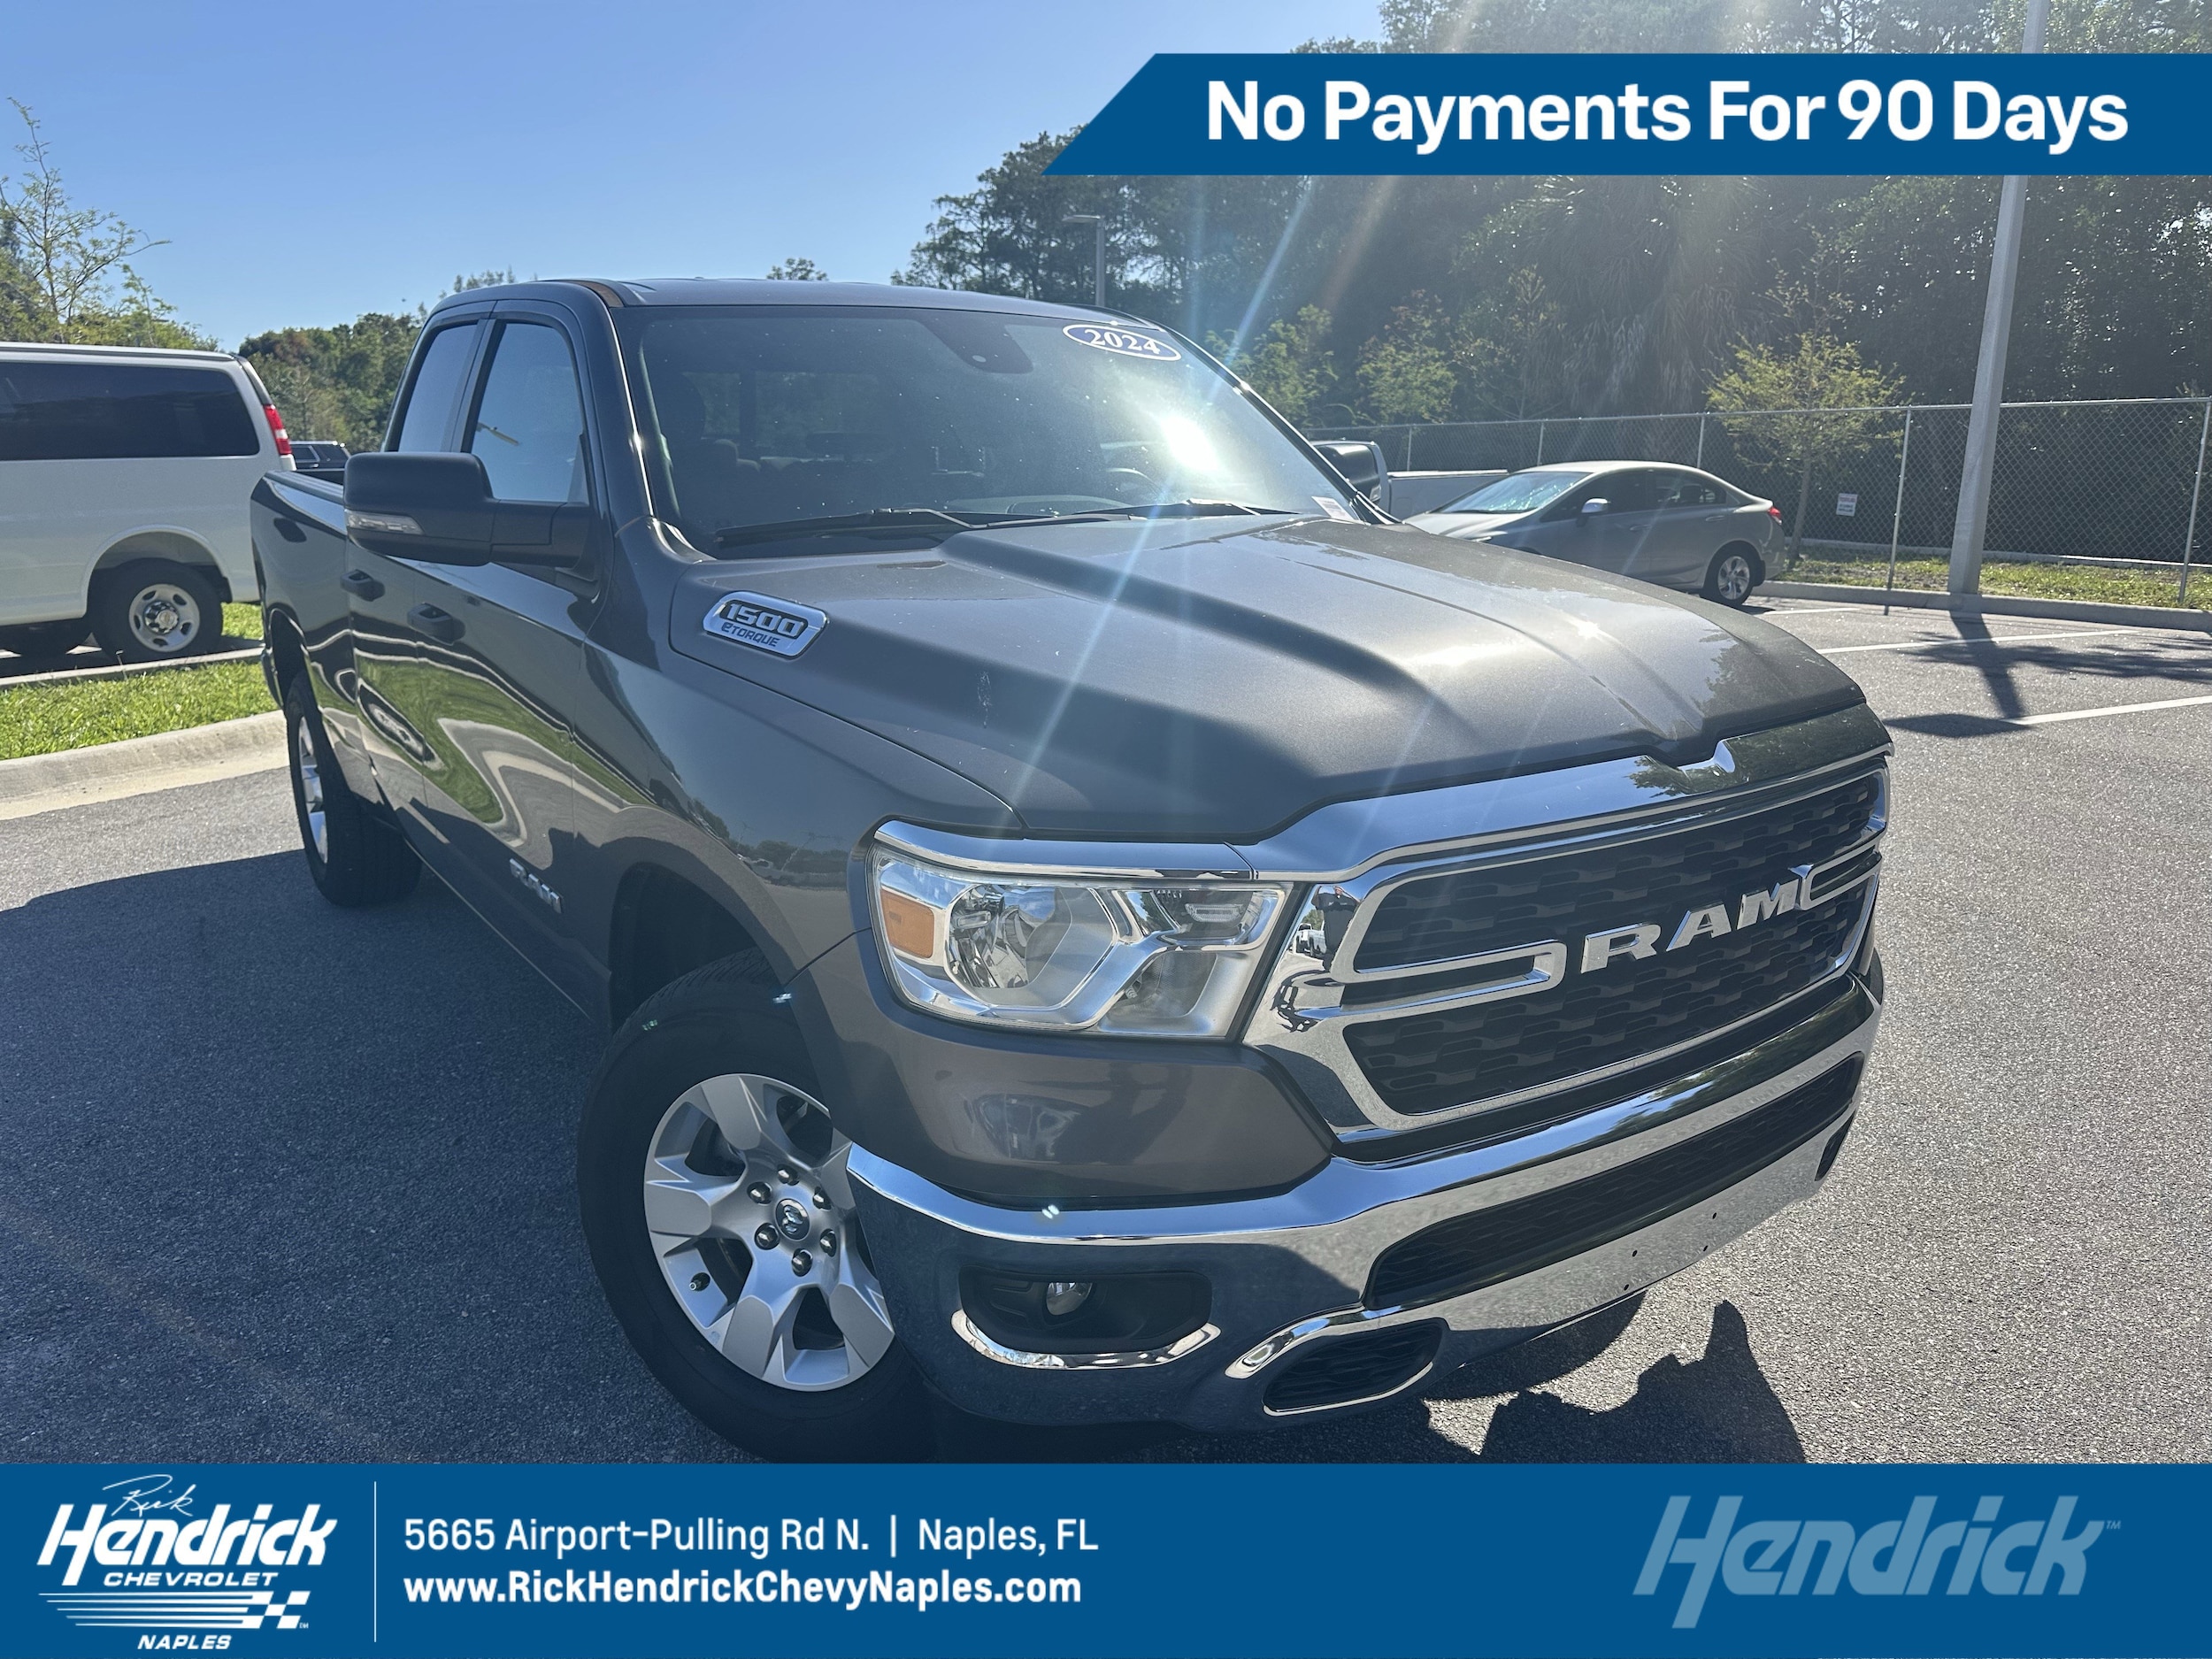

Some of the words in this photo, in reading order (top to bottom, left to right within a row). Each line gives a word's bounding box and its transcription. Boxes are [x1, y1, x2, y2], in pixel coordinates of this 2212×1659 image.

[1084, 328, 1161, 355] 2024
[726, 603, 804, 638] 1500
[509, 858, 562, 914] RAM
[1580, 878, 1801, 974] RAM
